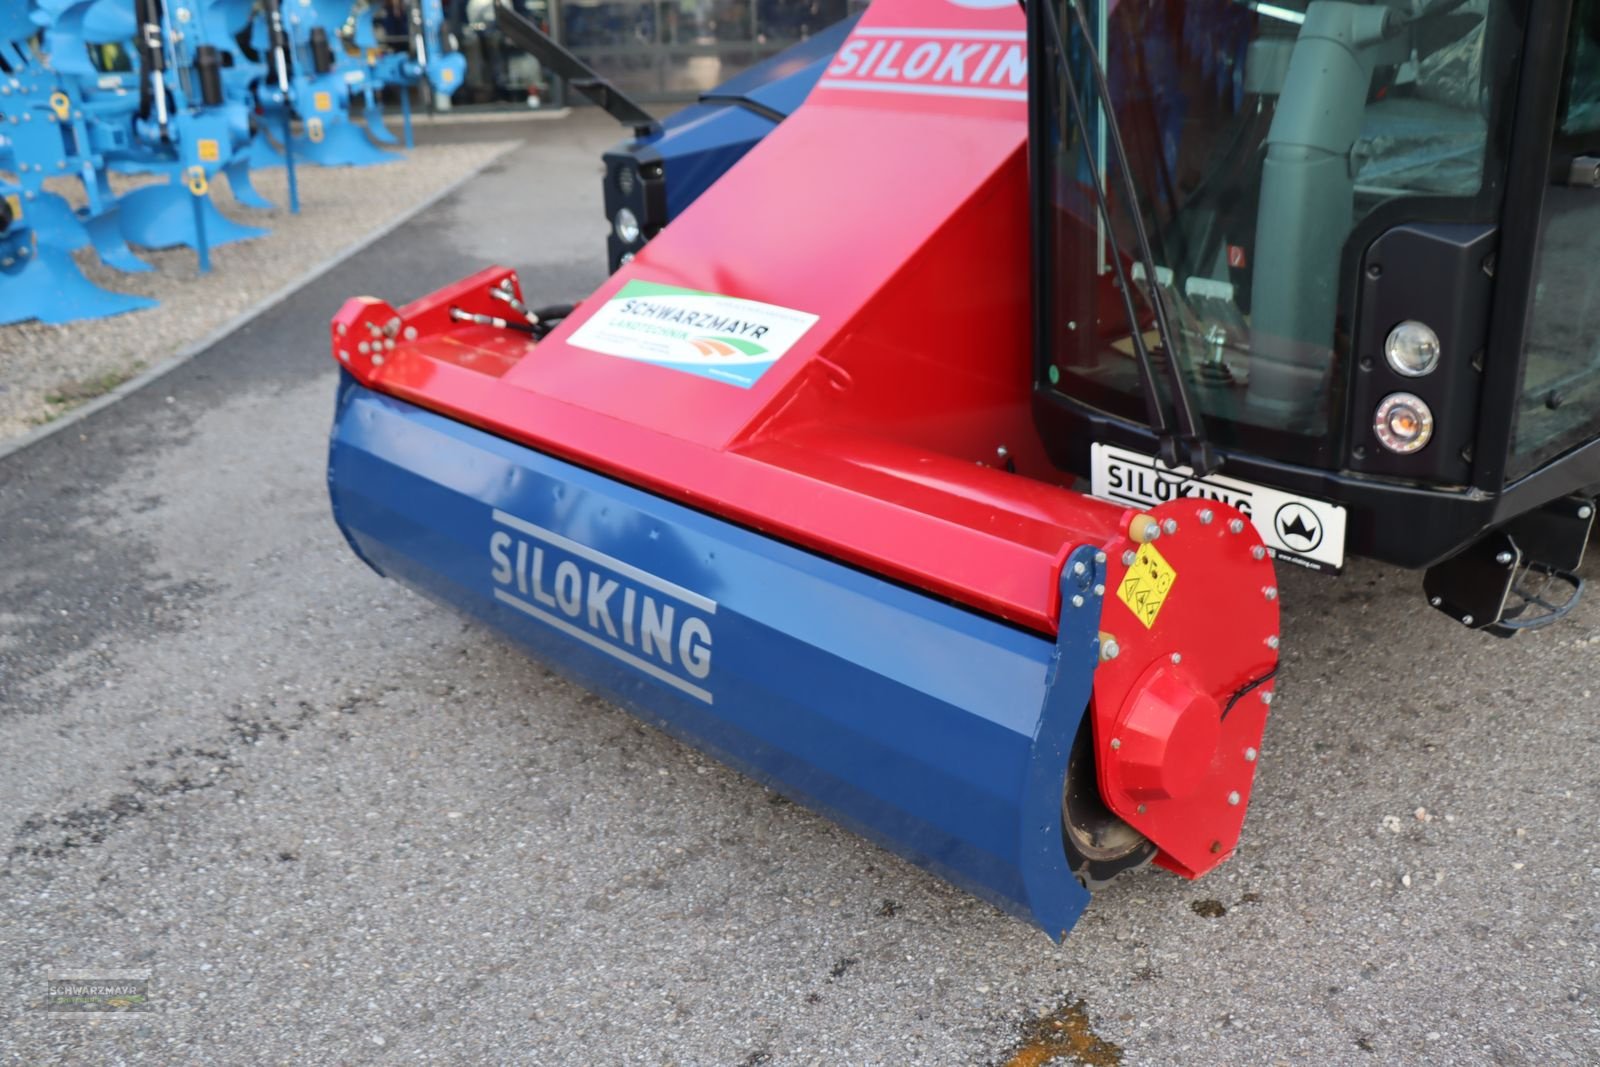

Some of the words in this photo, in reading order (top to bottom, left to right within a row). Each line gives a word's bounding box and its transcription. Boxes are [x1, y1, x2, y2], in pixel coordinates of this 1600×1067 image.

[828, 39, 1028, 86] SILOKIN
[620, 300, 770, 339] SCHWARZMAYR
[490, 531, 712, 679] SILOKING
